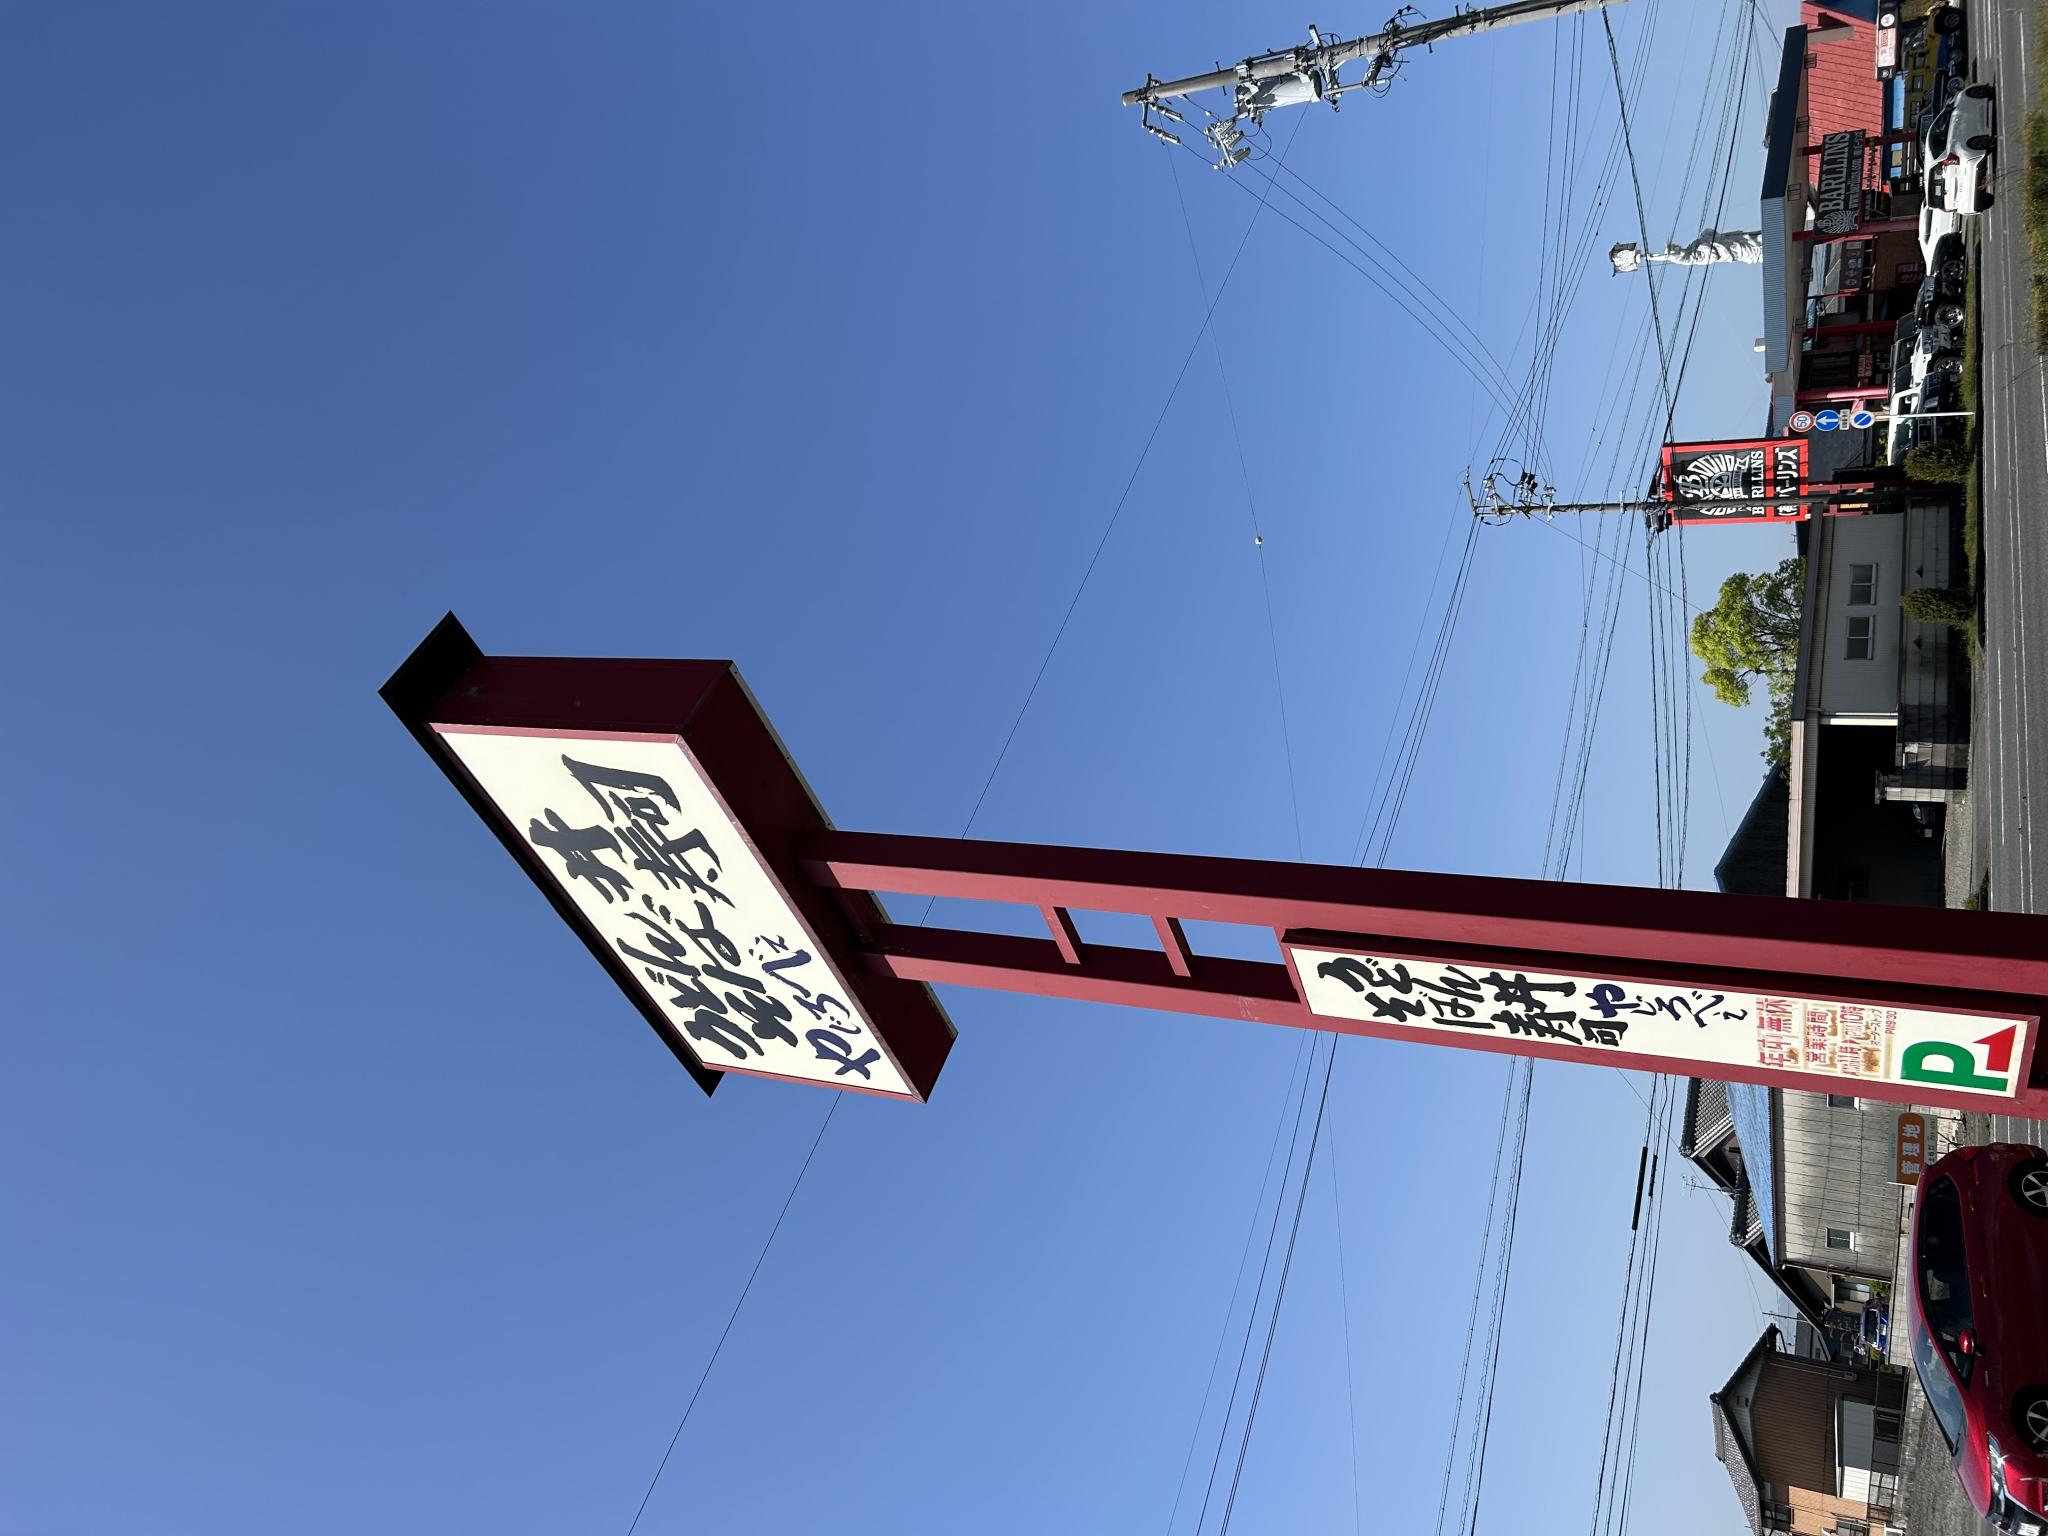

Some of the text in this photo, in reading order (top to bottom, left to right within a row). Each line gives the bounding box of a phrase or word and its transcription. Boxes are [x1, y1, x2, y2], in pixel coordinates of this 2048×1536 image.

[1819, 132, 1850, 212] BARLLINS
[1796, 415, 1808, 427] 50
[1751, 450, 1765, 515] BRLLINS
[1757, 998, 1793, 1068] 年中無休
[1805, 1010, 1829, 1063] 営業時間
[1900, 1041, 2008, 1092] P
[1901, 1124, 1920, 1175] 管理地
